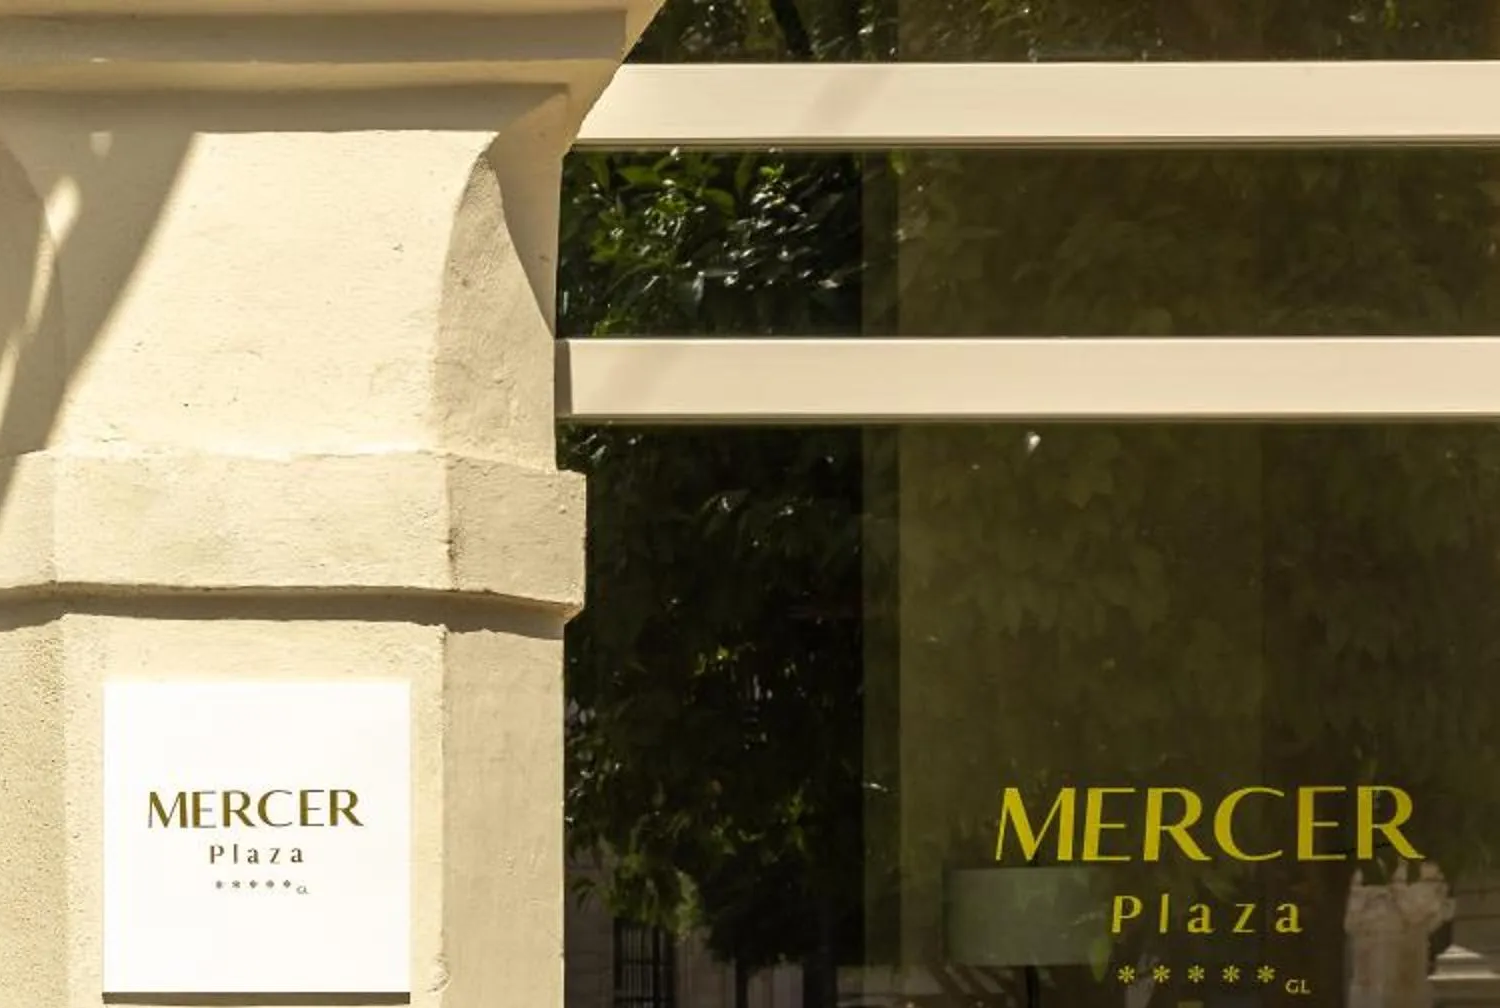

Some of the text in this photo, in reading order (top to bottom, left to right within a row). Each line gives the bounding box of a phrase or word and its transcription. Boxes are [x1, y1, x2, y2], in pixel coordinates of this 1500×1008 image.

[147, 789, 365, 829] MERCER
[995, 785, 1427, 862] MERCER
[209, 843, 304, 865] Plaza
[1111, 893, 1303, 934] Plaza
[1285, 978, 1312, 995] GL
